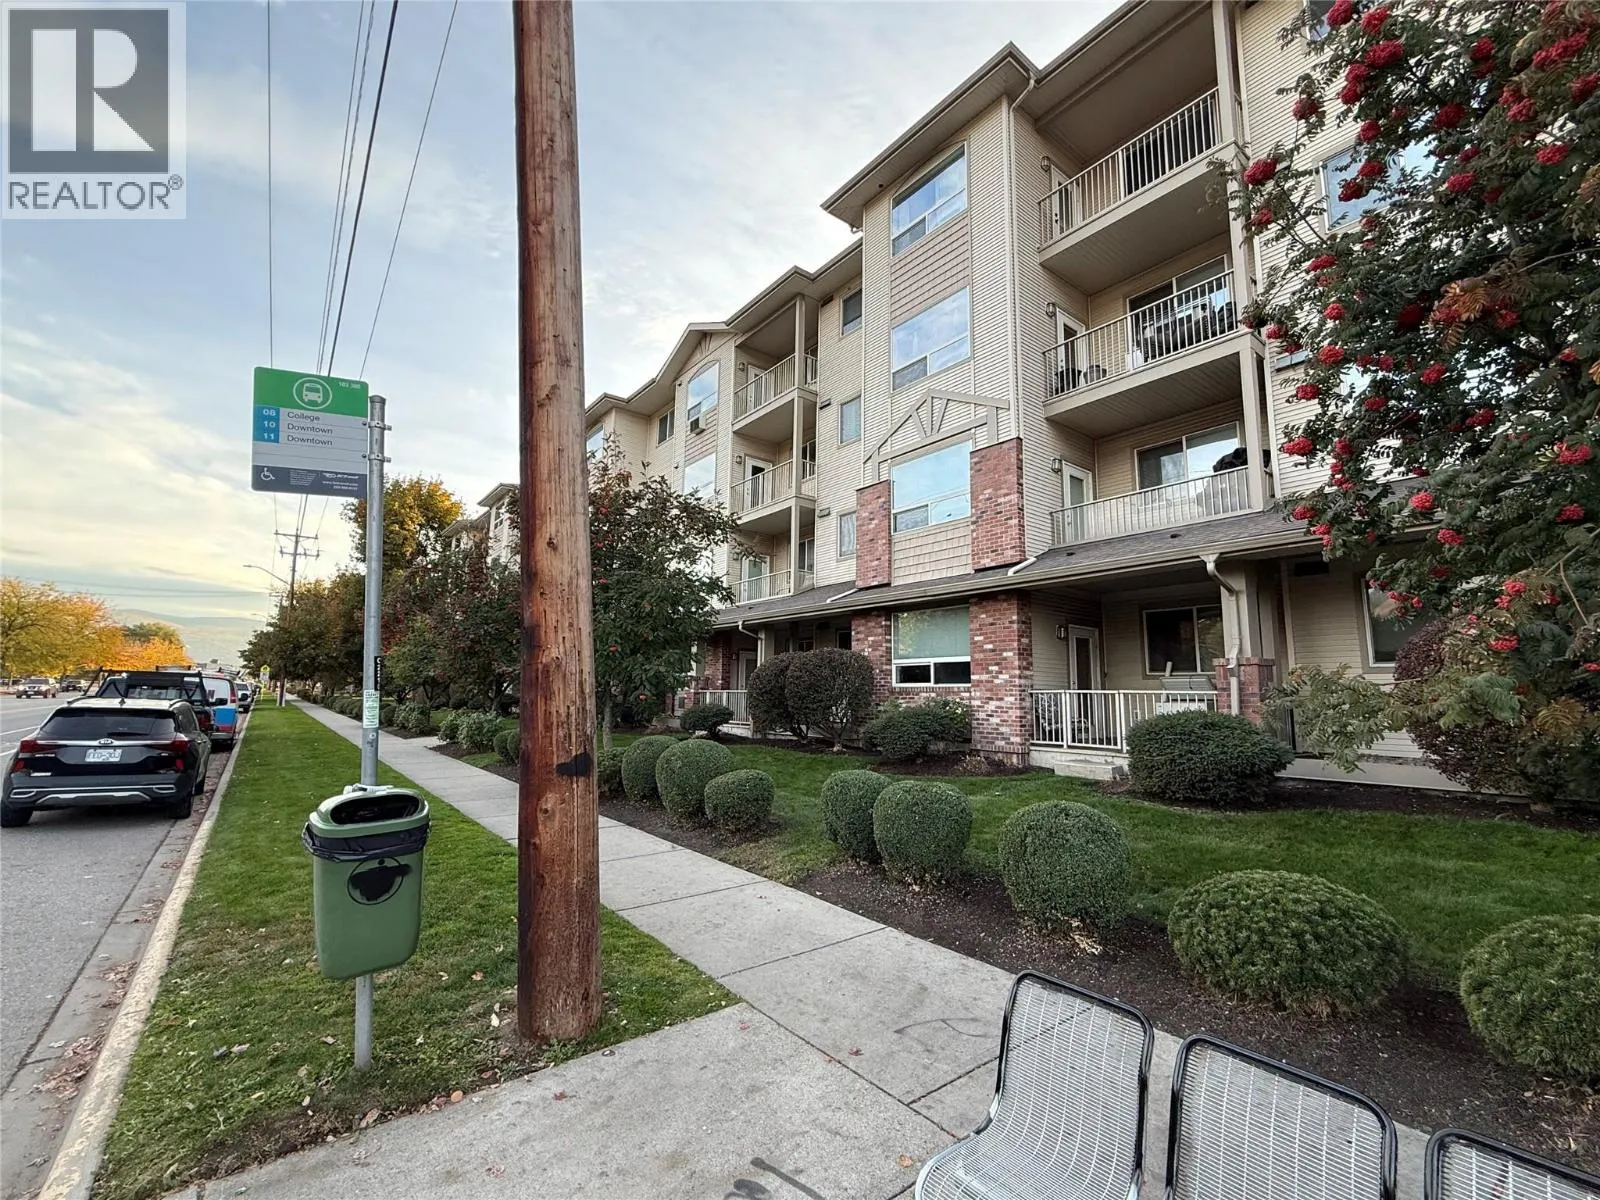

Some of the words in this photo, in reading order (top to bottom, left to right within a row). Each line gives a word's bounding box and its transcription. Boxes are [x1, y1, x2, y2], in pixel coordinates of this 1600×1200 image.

[262, 408, 277, 417] 08
[287, 411, 321, 422] College
[263, 420, 276, 429] 10
[287, 422, 333, 435] Downtown
[263, 432, 275, 440] 11
[287, 434, 333, 446] Downtown
